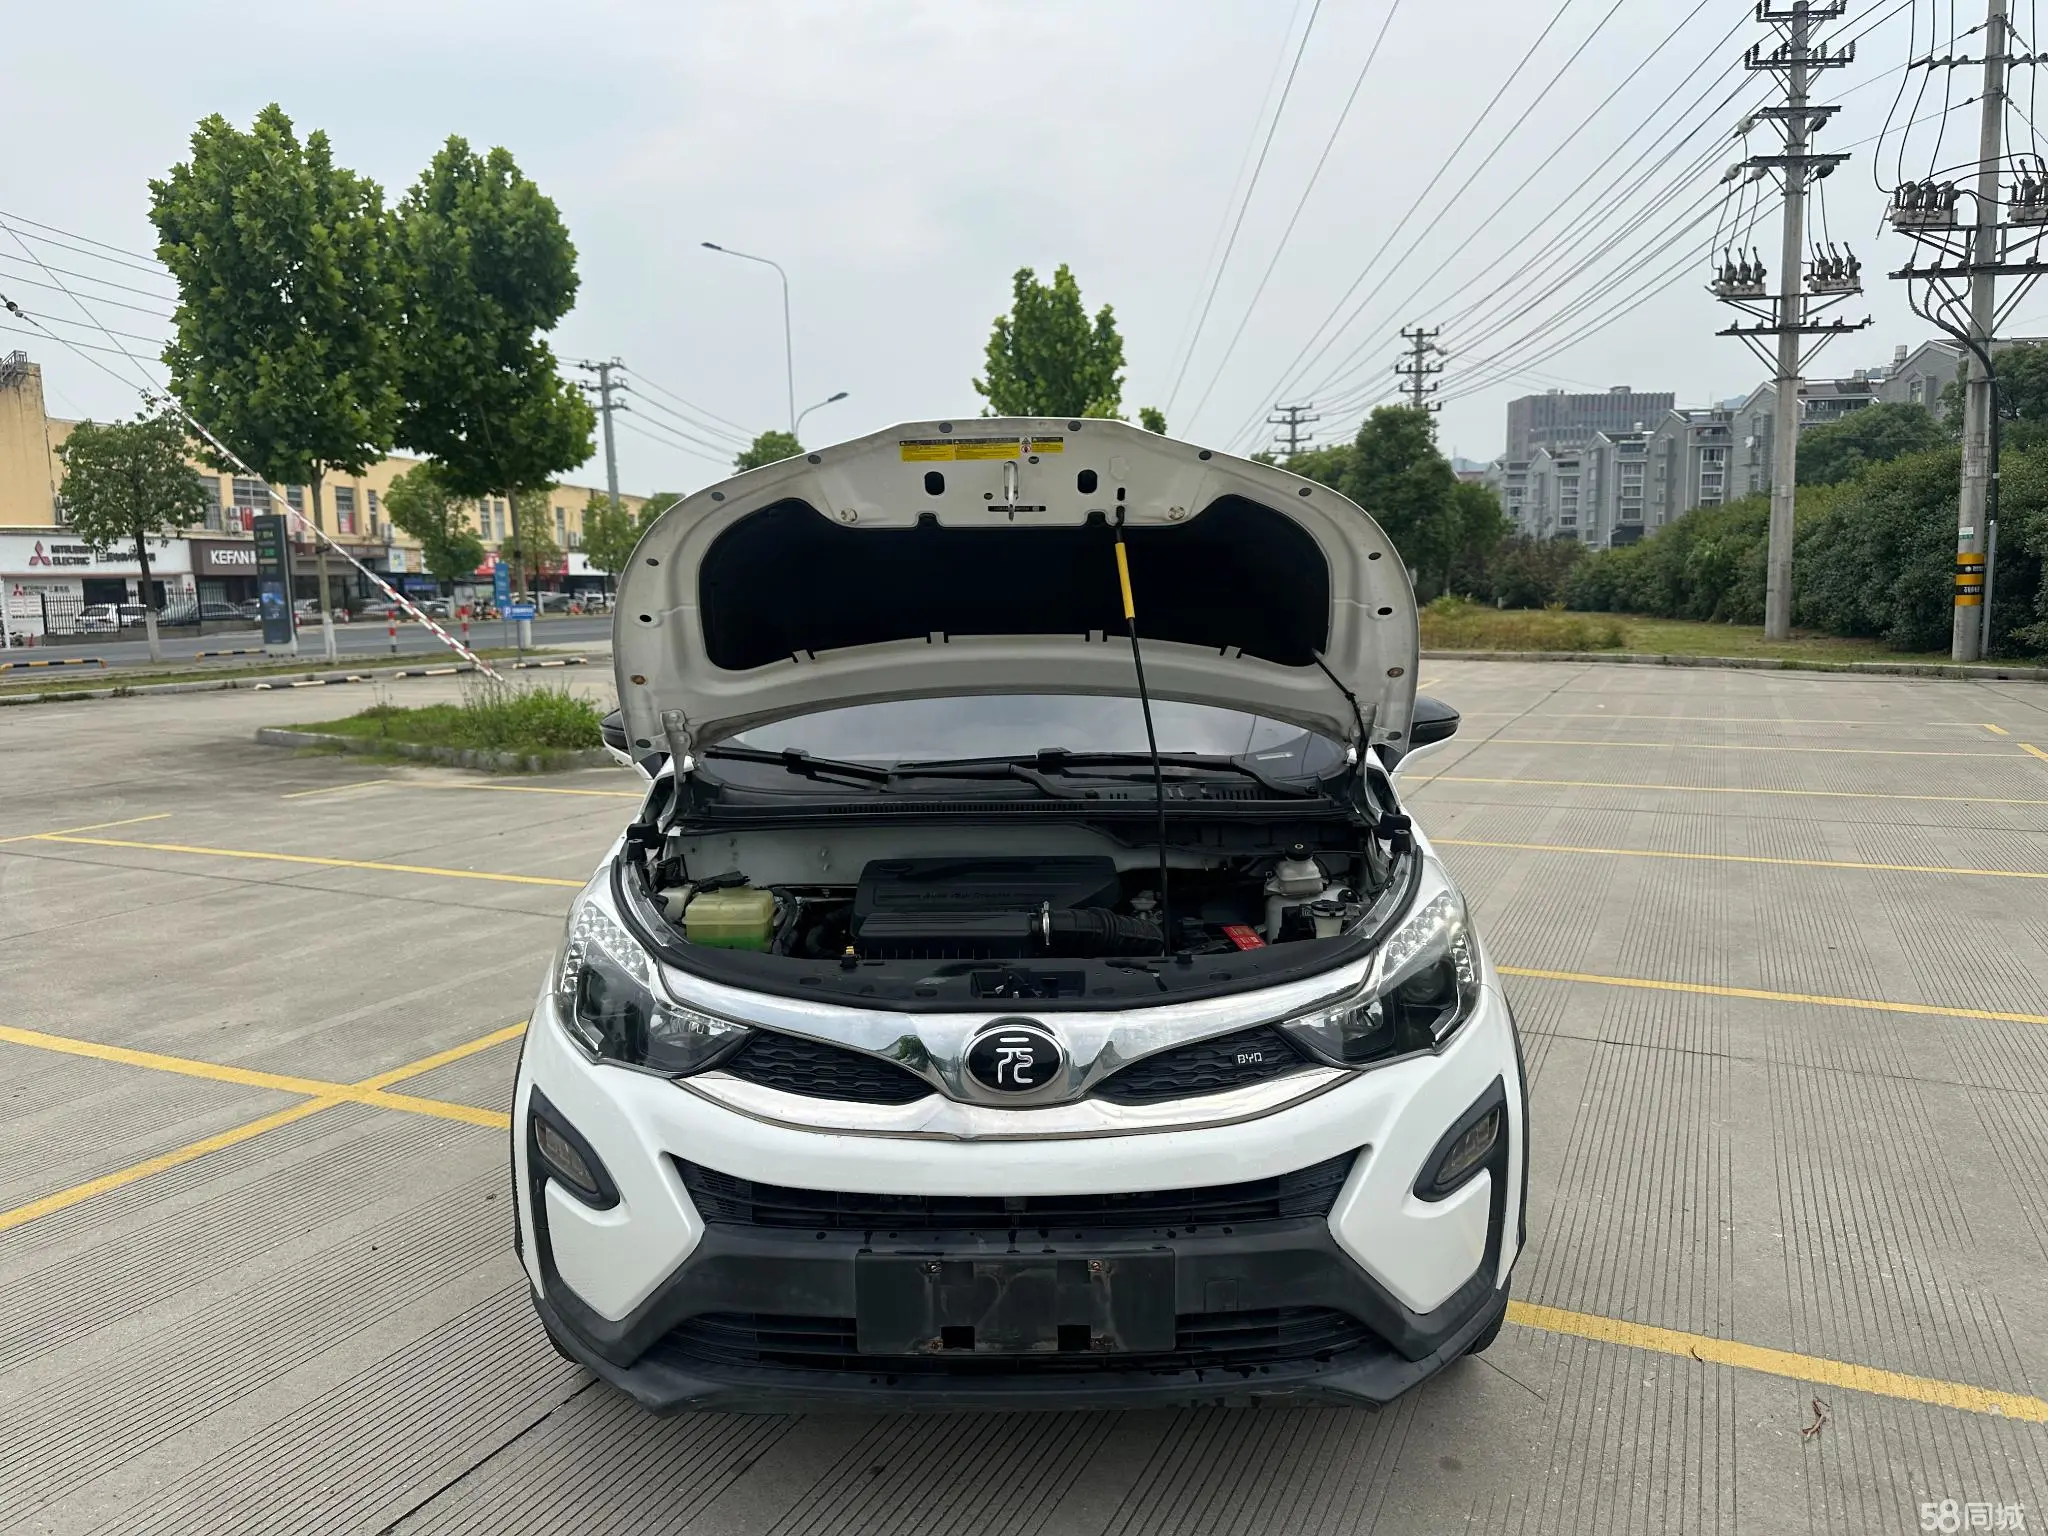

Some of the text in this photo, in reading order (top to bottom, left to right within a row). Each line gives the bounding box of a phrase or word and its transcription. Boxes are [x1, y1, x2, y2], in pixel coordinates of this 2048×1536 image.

[52, 556, 90, 566] ELECTRIC
[211, 549, 249, 565] KEFAN
[996, 1037, 1033, 1084] 元
[1237, 1052, 1263, 1064] BYD
